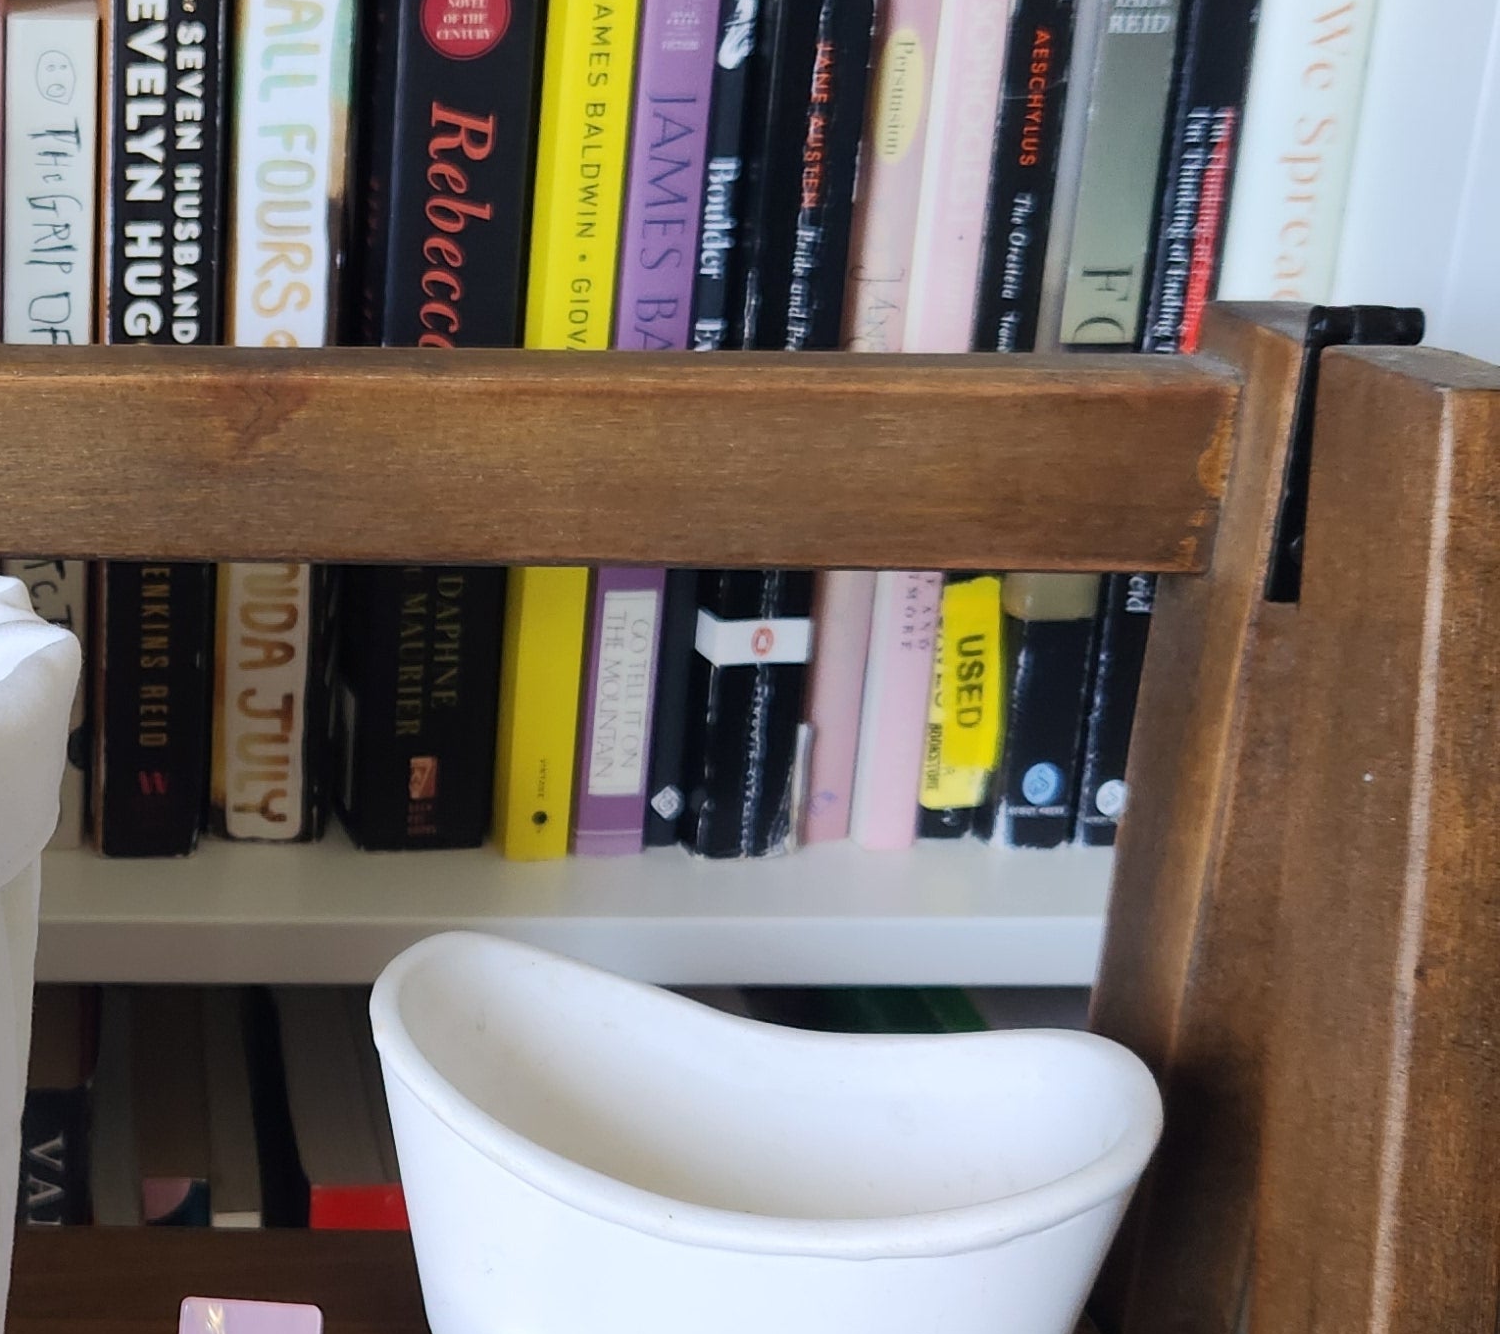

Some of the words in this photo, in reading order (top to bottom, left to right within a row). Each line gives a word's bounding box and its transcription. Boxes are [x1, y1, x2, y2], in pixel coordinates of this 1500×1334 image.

[436, 27, 493, 41] CENTURY
[442, 12, 462, 25] OF
[464, 11, 489, 25] THE
[1107, 11, 1173, 34] REID
[173, 20, 207, 151] SEVEN
[809, 40, 836, 105] JANE
[1019, 28, 1050, 166] AESCHYLUS
[574, 101, 607, 239] BALDWIN
[640, 90, 697, 274] JAMES
[799, 113, 829, 211] AUSTEN
[24, 194, 83, 276] GRIP
[251, 123, 318, 319] FOURS
[701, 156, 742, 281] Boulder
[1010, 192, 1034, 225] The
[1270, 117, 1338, 300] Sprea
[566, 276, 592, 349] GIOV
[394, 592, 429, 739] MAURIER
[431, 574, 465, 709] DAPHNE
[606, 610, 627, 650] THE
[630, 618, 651, 653] GO
[138, 684, 170, 748] REID
[594, 658, 622, 779] MOUNTAIN
[624, 710, 642, 729] IT
[626, 658, 647, 701] TELL
[955, 633, 986, 730] USED
[231, 685, 295, 824] JULY
[620, 734, 639, 769] ON
[924, 722, 942, 793] BOOKSTORE
